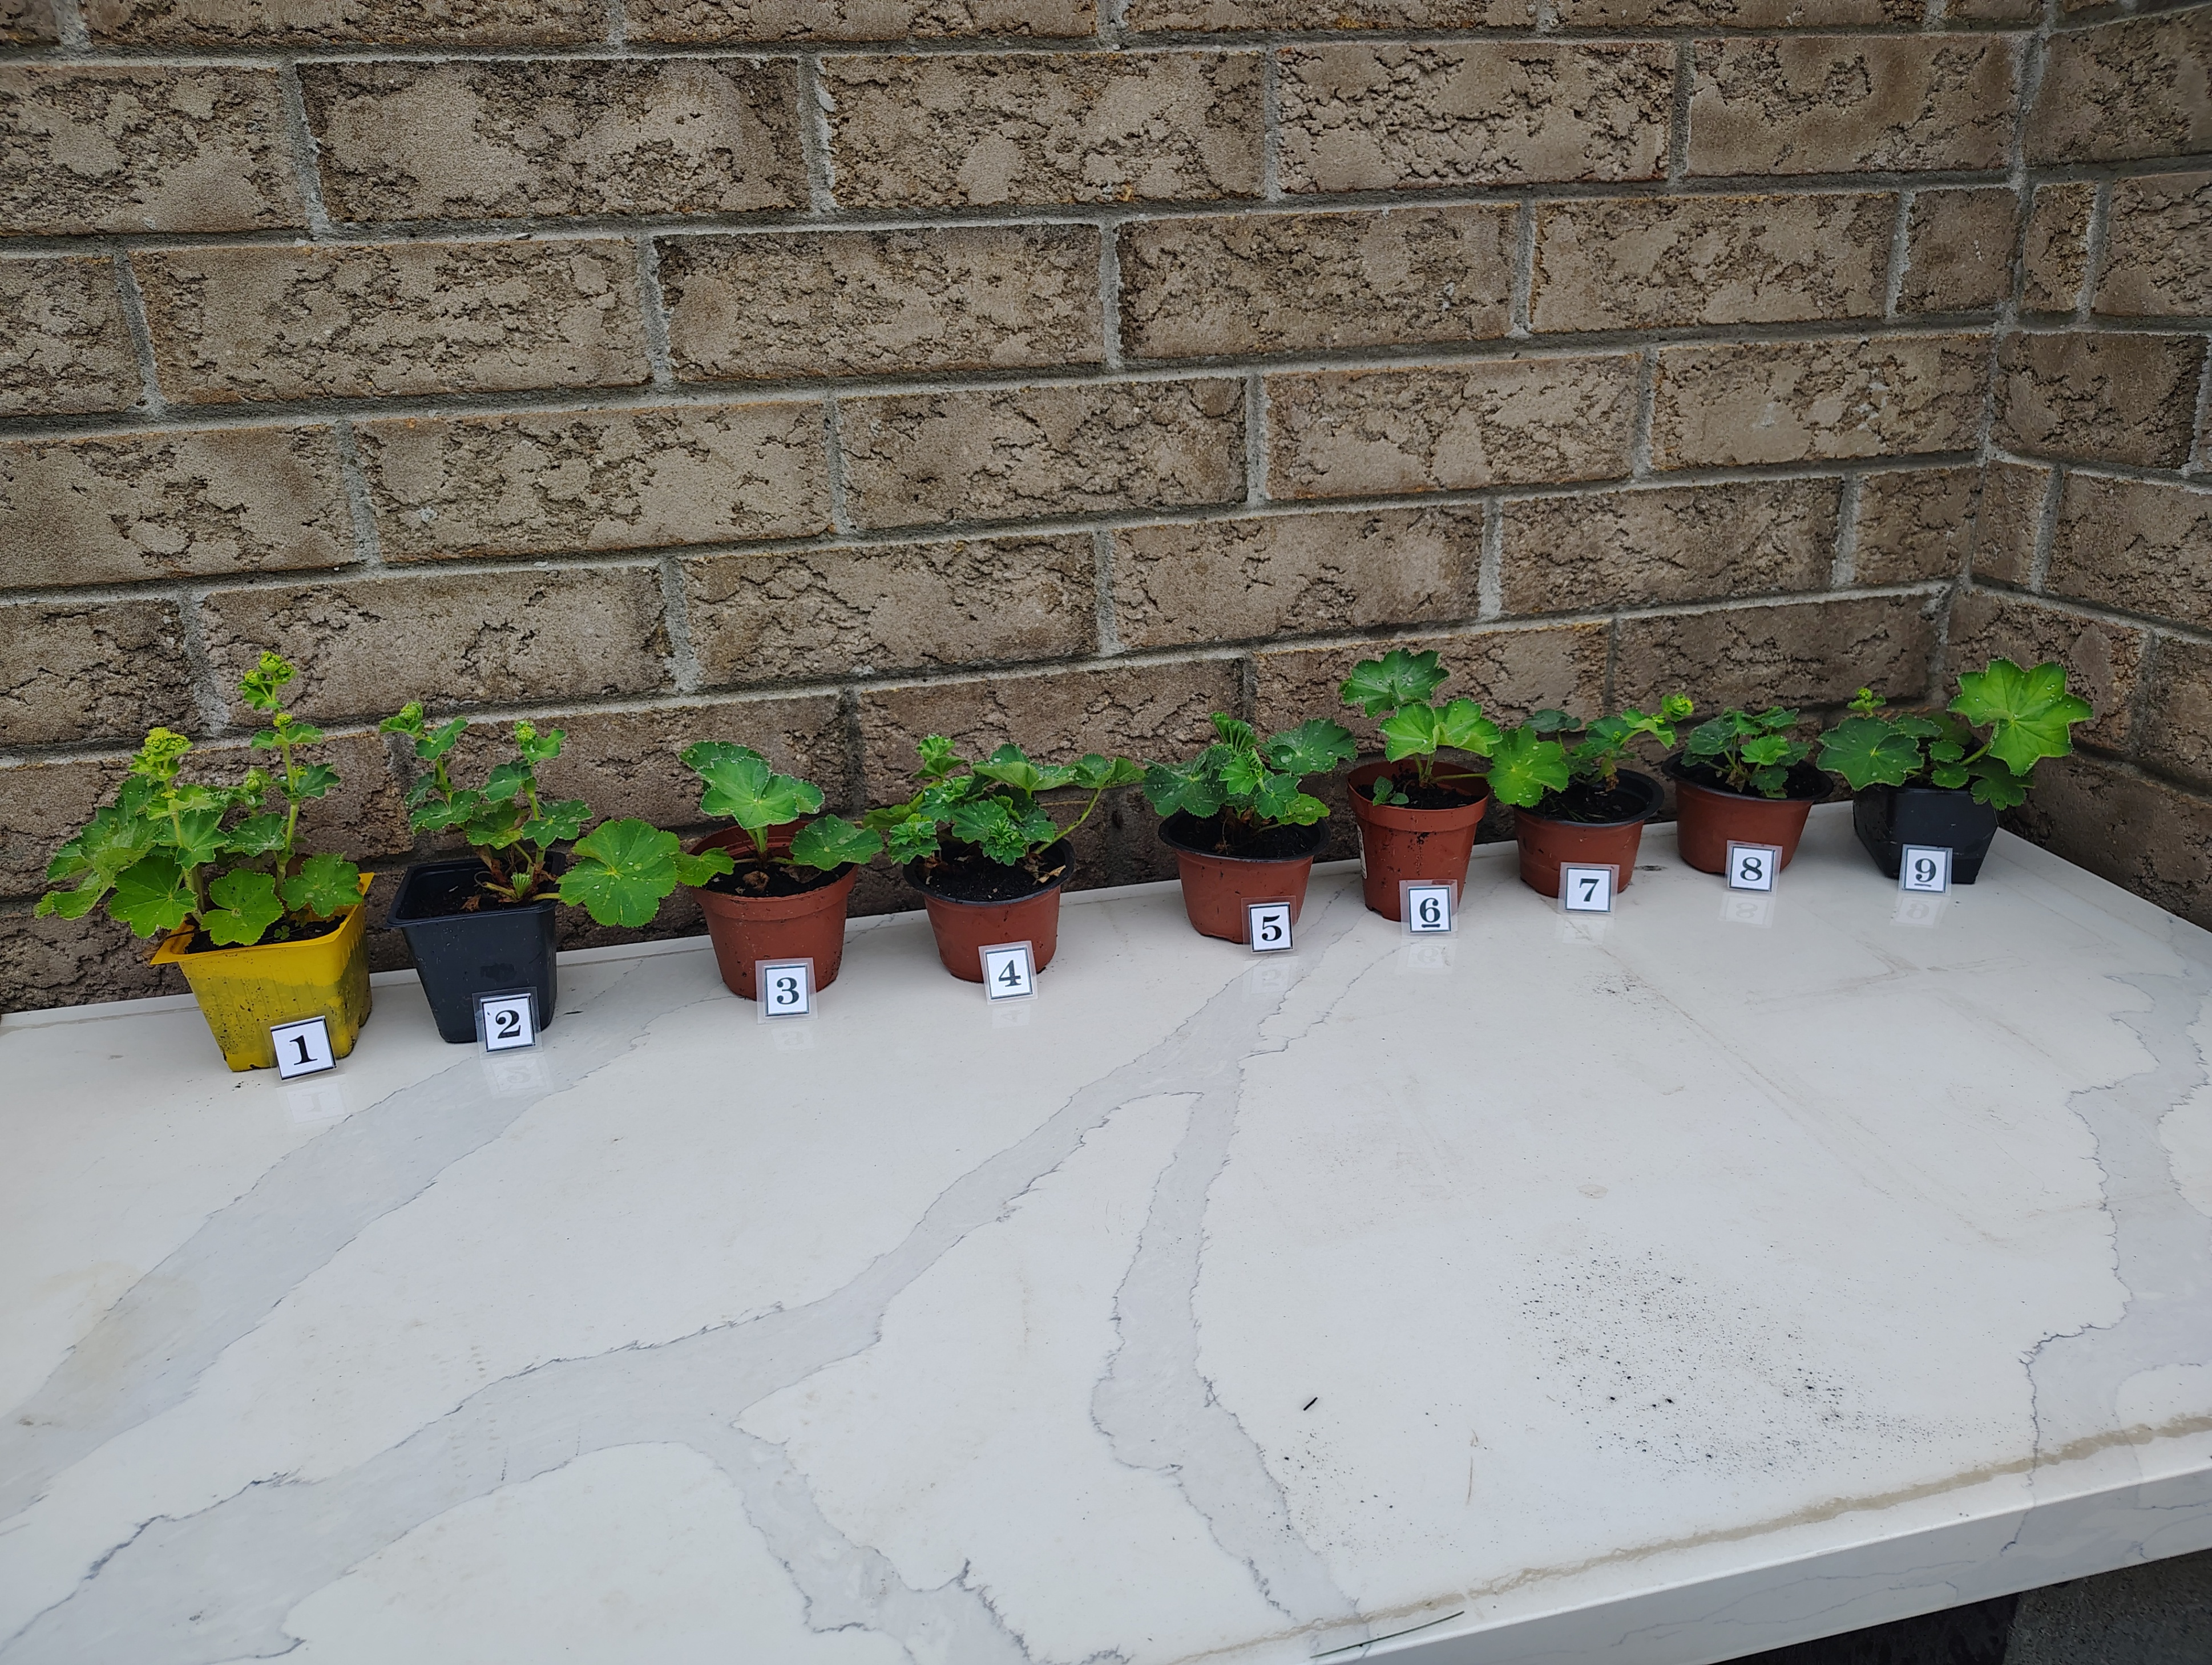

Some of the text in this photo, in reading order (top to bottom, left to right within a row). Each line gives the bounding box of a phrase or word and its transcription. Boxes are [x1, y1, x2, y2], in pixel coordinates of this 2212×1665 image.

[1740, 857, 1762, 881] 8
[1915, 858, 1936, 883] 9
[1580, 878, 1600, 902] 7
[1420, 898, 1440, 922] 6
[1262, 915, 1282, 941] 5
[999, 960, 1022, 987] 4
[777, 977, 800, 1004] 3
[495, 1010, 521, 1039] 2
[290, 1035, 318, 1065] 1
